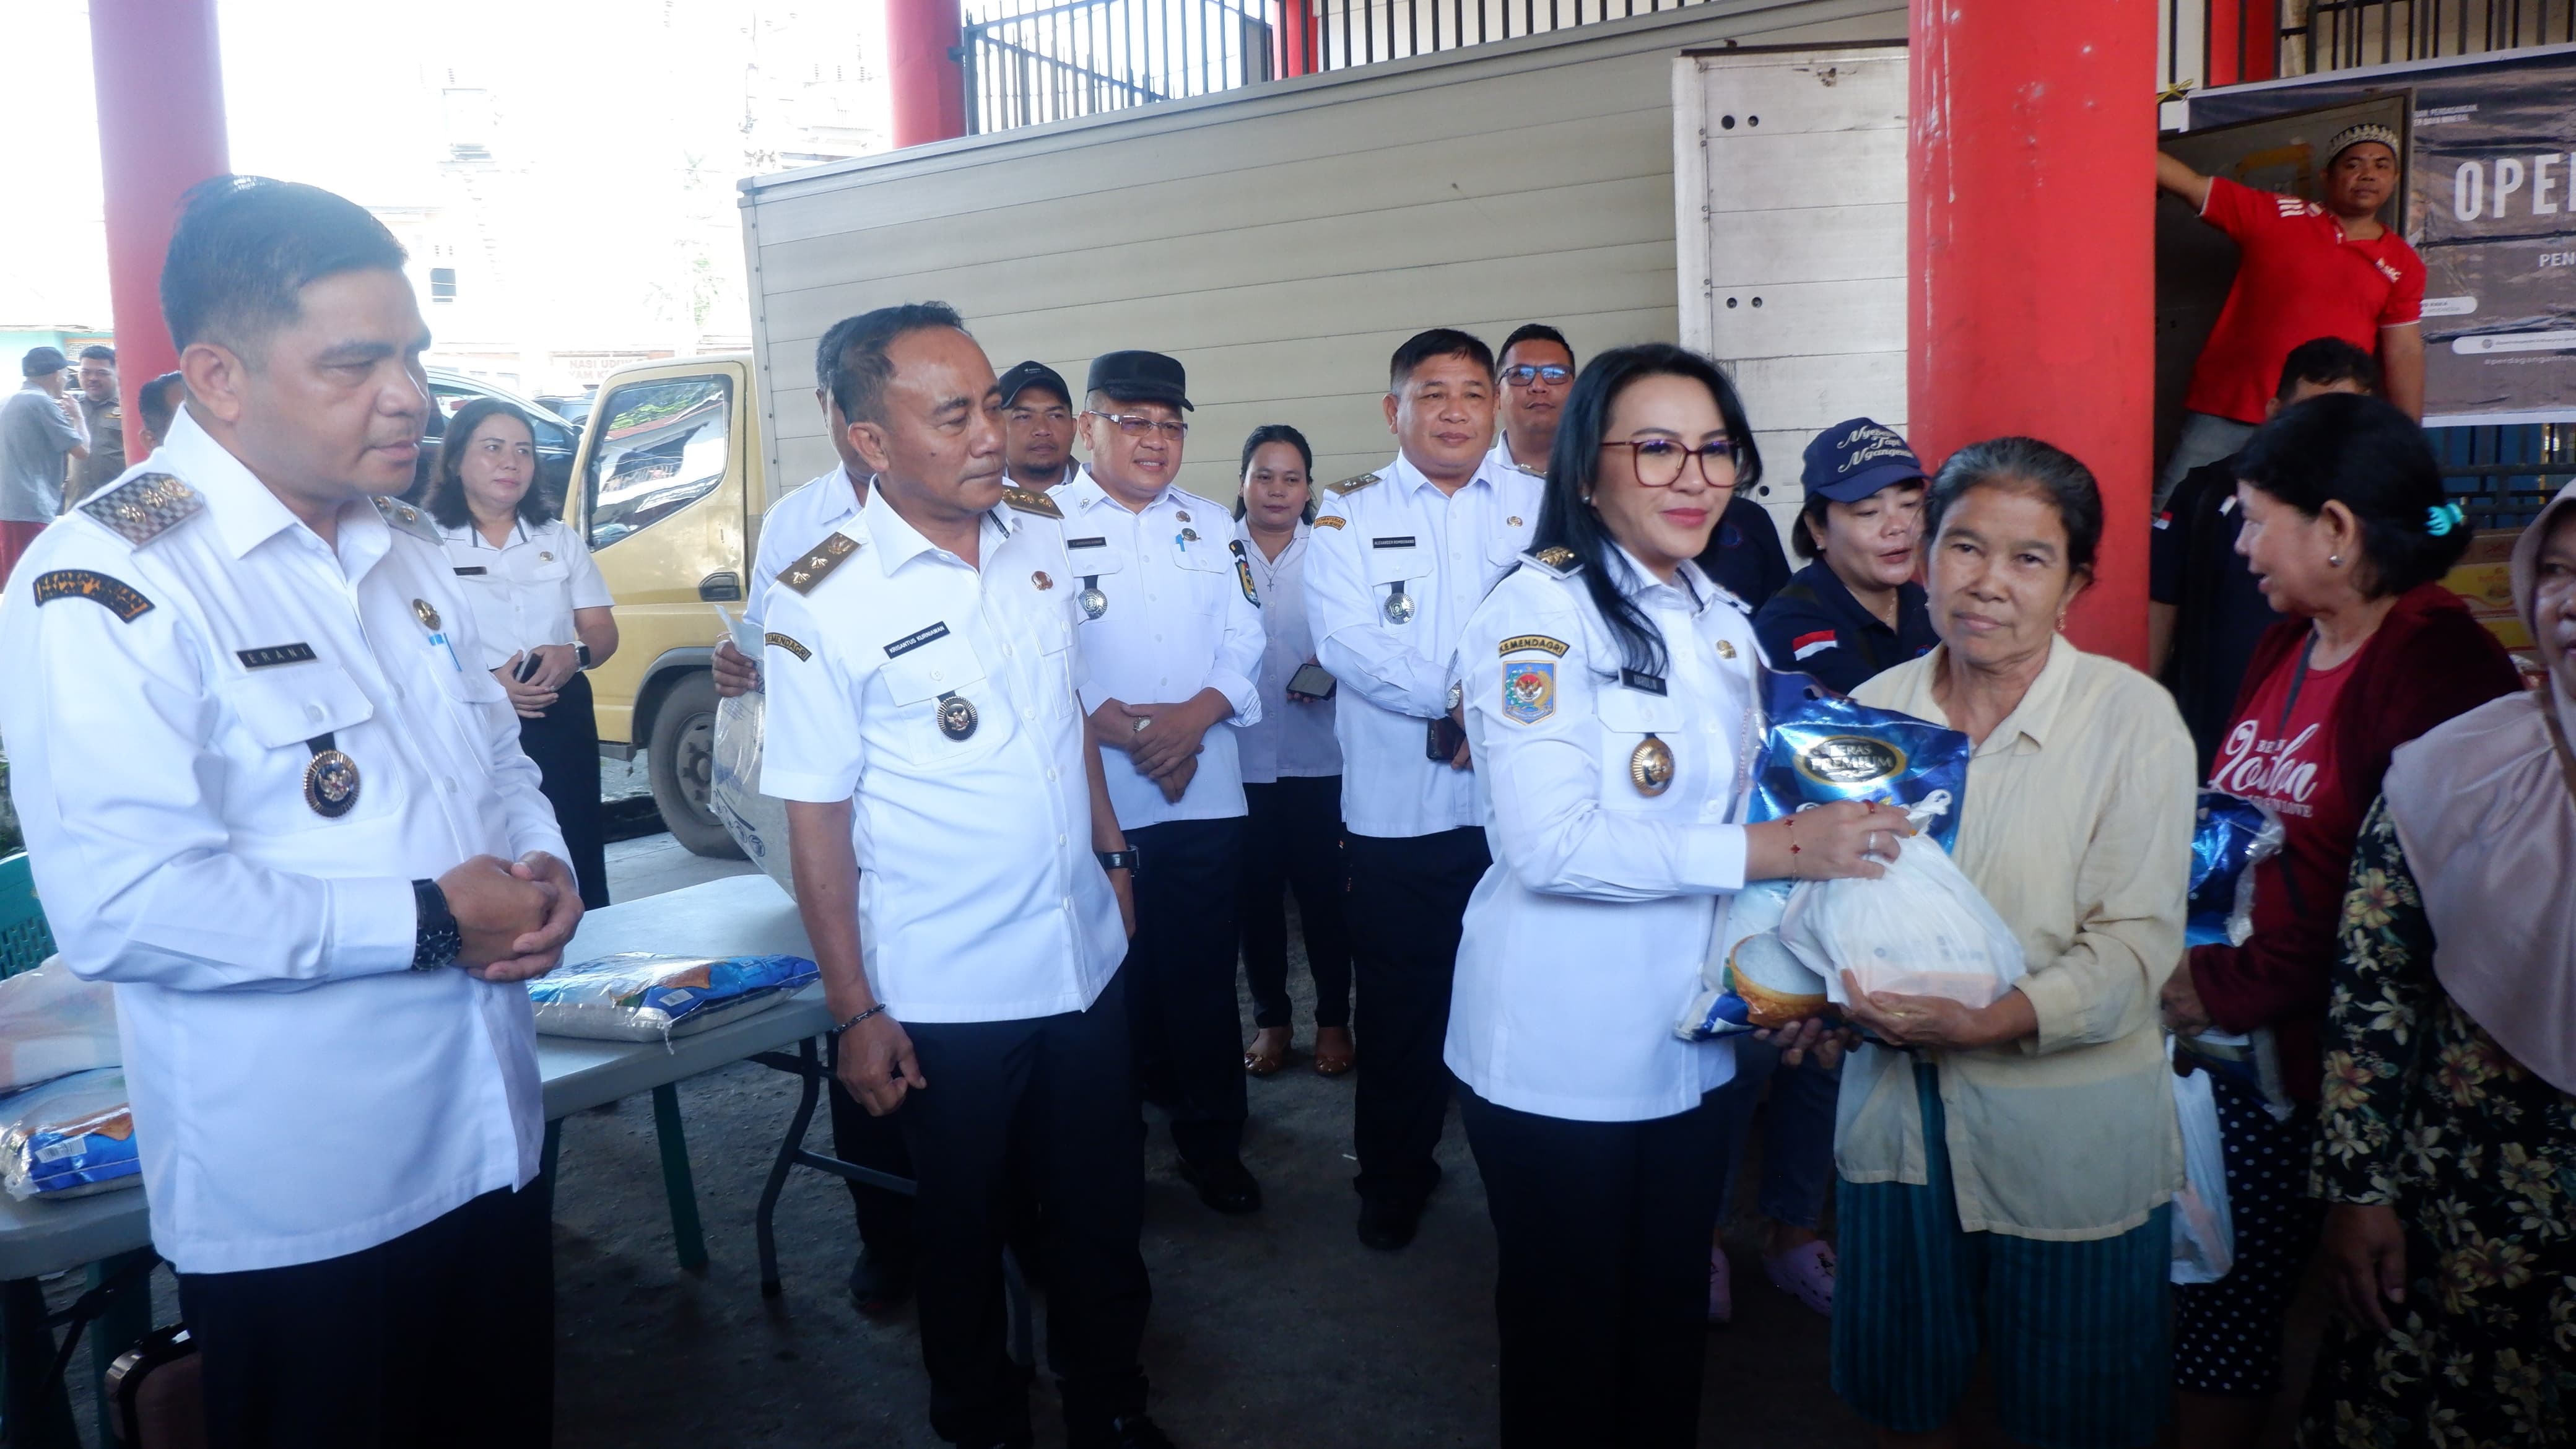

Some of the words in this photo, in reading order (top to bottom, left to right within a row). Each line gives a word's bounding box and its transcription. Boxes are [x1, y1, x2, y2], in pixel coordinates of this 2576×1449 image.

[2539, 251, 2576, 267] PEN
[570, 359, 597, 368] NASI
[766, 634, 809, 659] EMENDAGRI
[889, 638, 916, 654] KRISANTUS
[916, 625, 946, 642] KURNIAWAN
[1499, 638, 1564, 654] KEMENDAGRI
